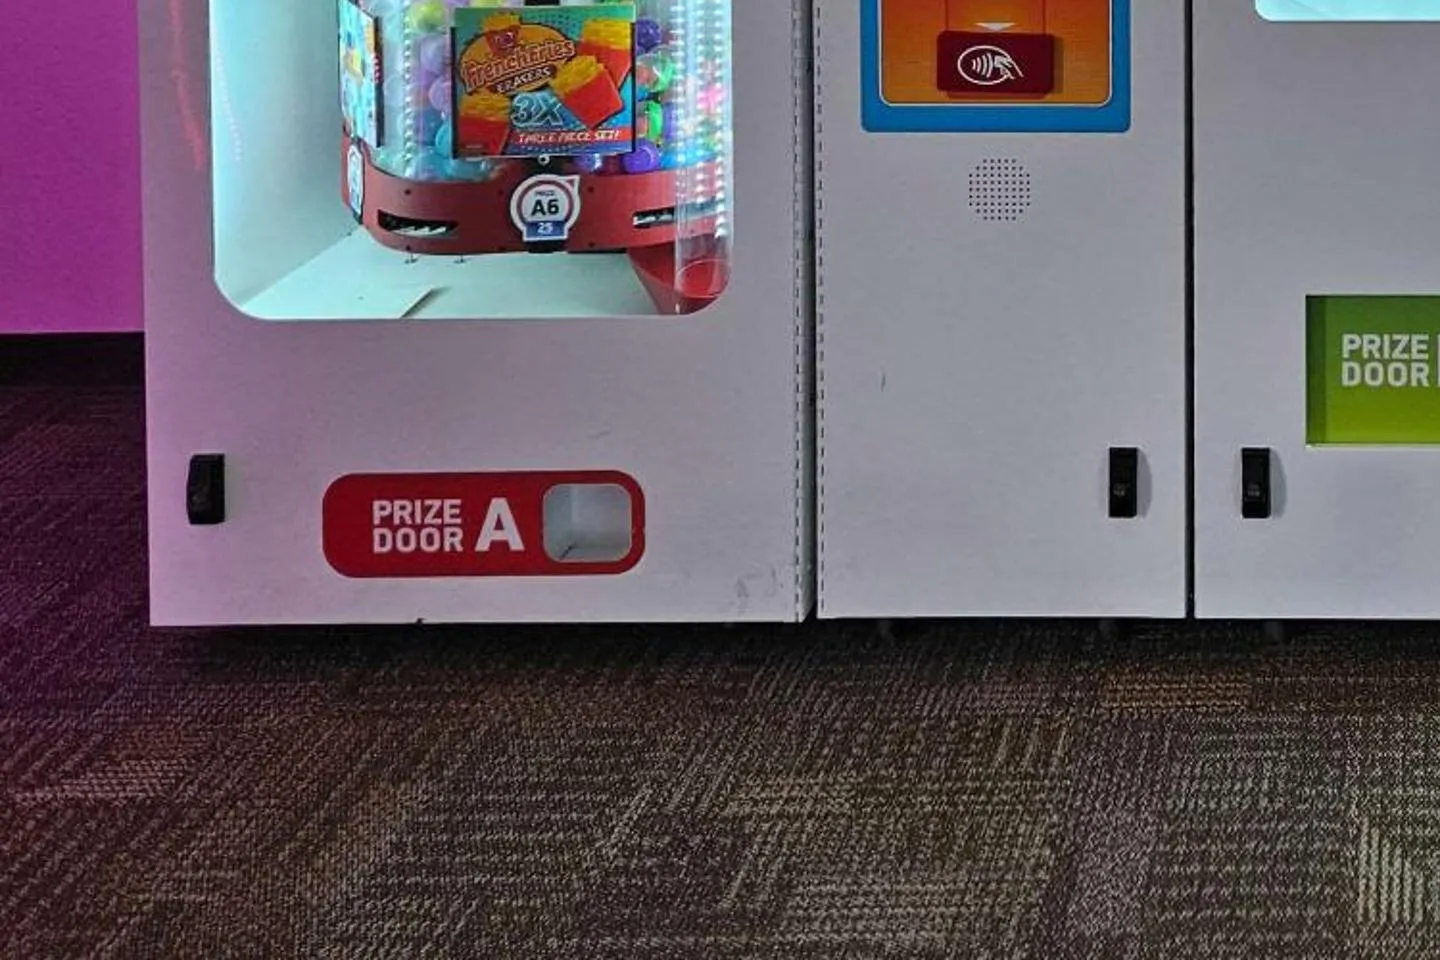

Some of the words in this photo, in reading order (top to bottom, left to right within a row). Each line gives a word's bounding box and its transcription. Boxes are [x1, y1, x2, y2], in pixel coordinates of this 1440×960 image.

[531, 199, 560, 216] A6
[1341, 333, 1429, 360] PRIZE
[1341, 361, 1430, 387] DOOR
[372, 498, 462, 525] PRIZE
[475, 497, 526, 552] A
[373, 527, 464, 553] DOOR
